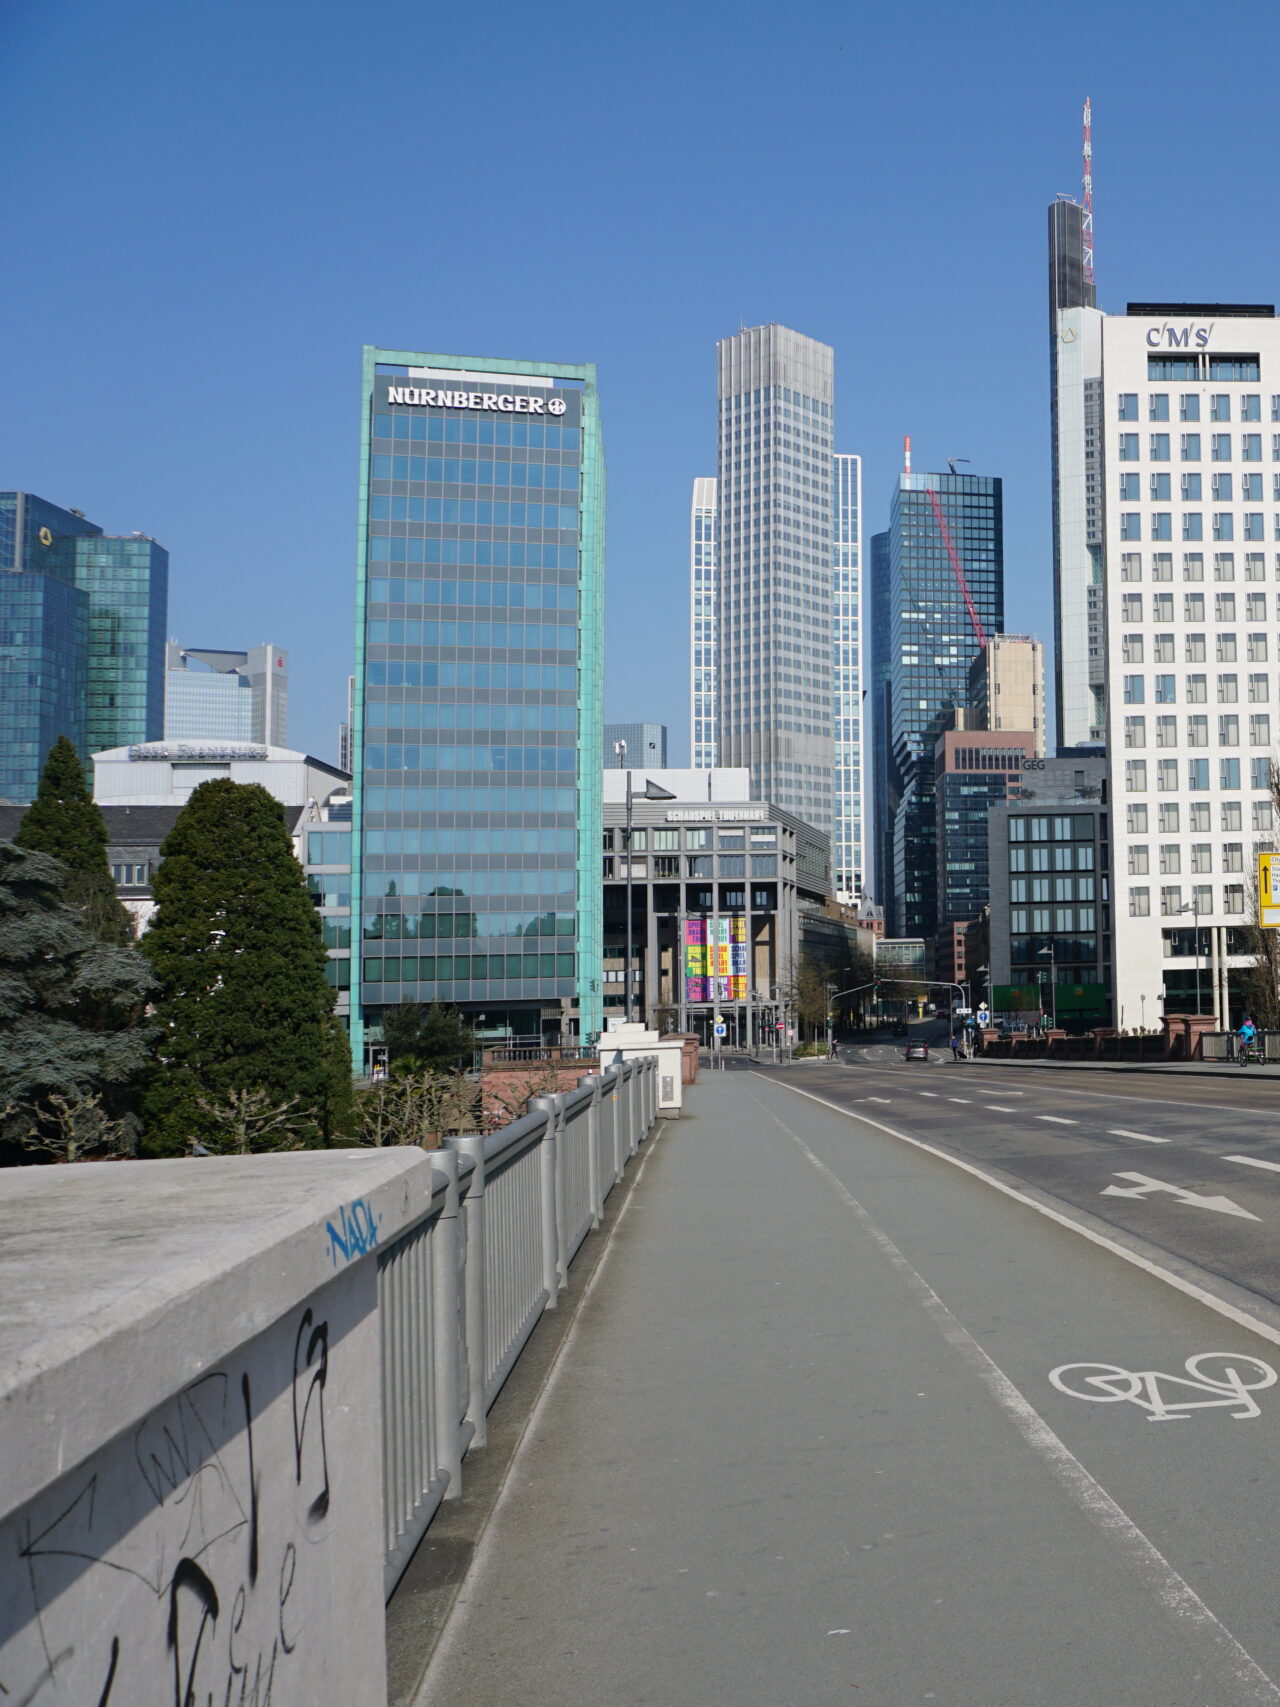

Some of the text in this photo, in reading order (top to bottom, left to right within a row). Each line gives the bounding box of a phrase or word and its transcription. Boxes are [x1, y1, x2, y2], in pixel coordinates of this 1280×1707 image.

[388, 386, 545, 414] NÜRNBERGER
[1022, 760, 1045, 770] GEG
[667, 809, 715, 821] SCHAUSPIEL
